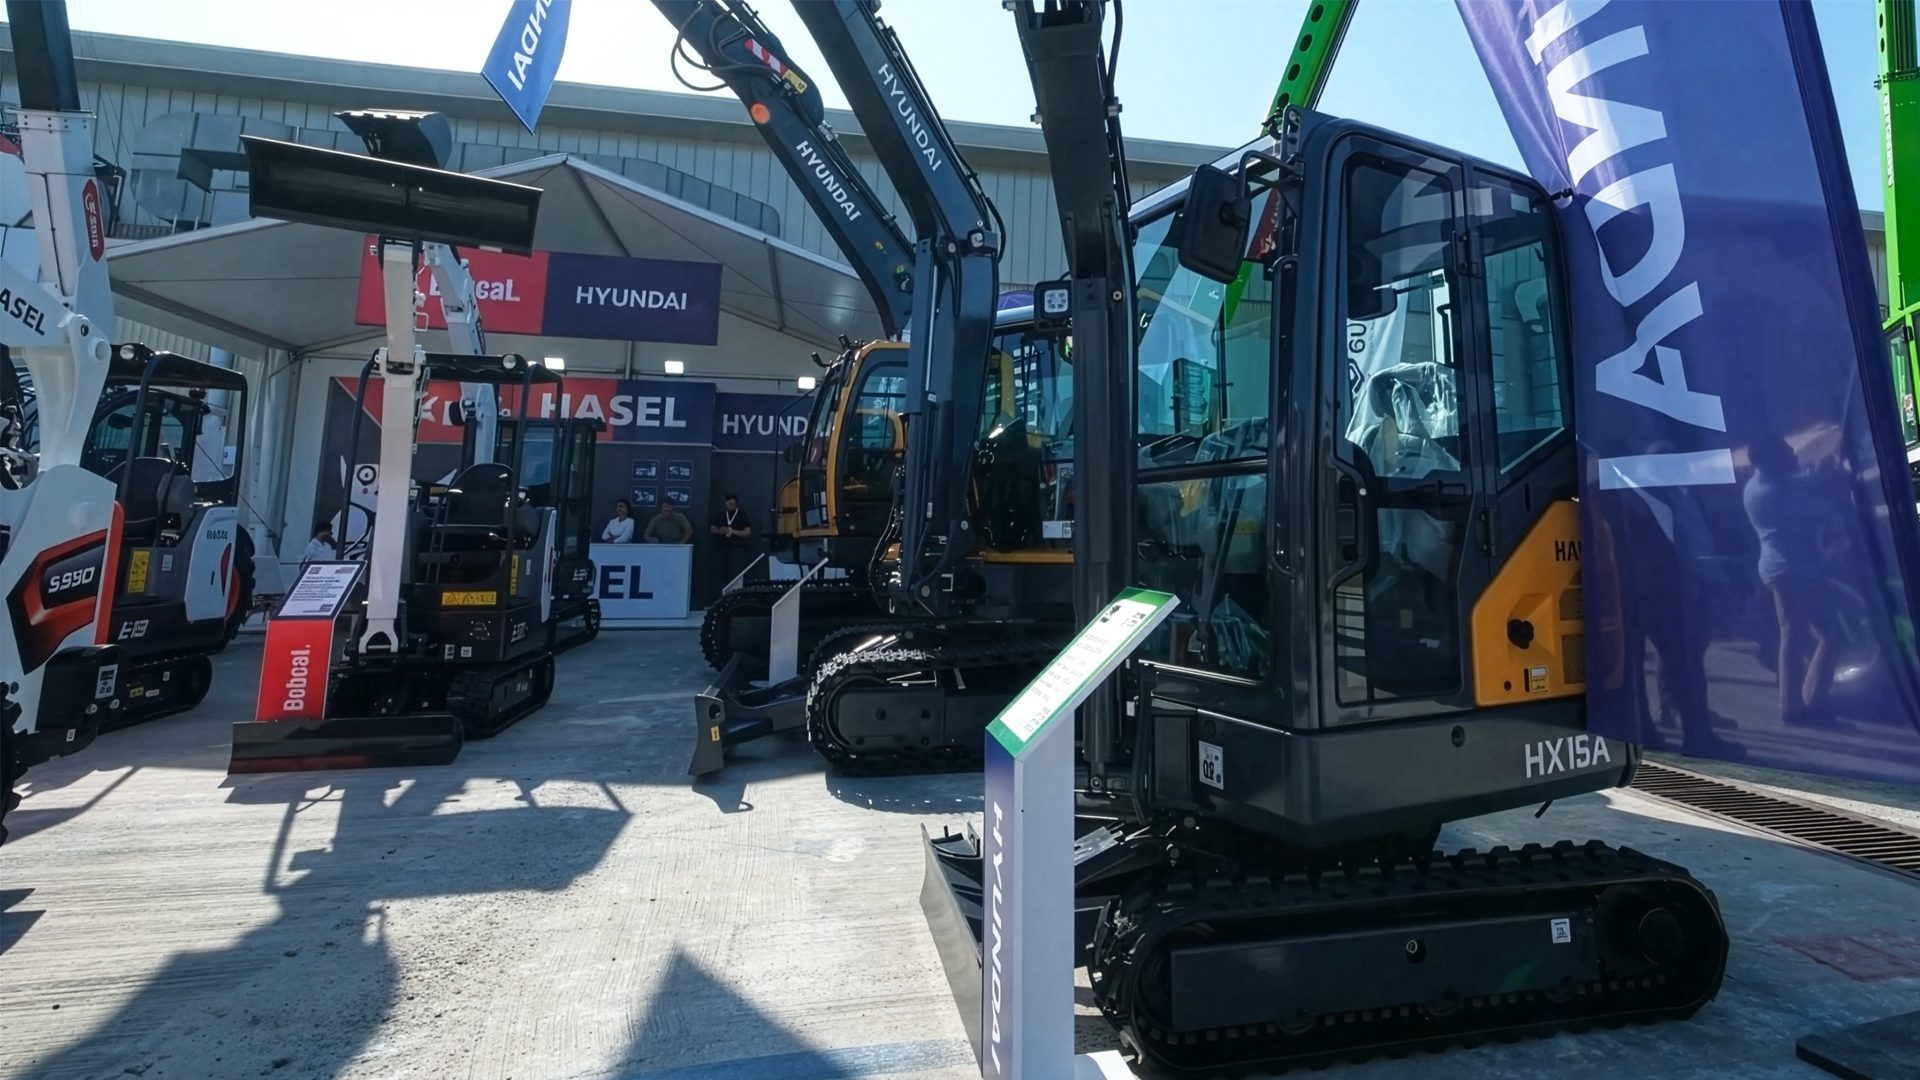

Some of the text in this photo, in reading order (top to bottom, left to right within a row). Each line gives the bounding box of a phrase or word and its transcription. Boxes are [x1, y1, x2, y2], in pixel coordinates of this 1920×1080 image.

[877, 63, 942, 172] HYUNDAI
[796, 140, 862, 222] HYUNDAI
[0, 288, 46, 336] ASEL
[575, 285, 688, 311] HYUNDAI
[540, 392, 687, 428] HASEL
[722, 413, 828, 437] HYUND
[1524, 734, 1611, 779] HX15A
[991, 801, 1003, 1075] HYUNDAI
